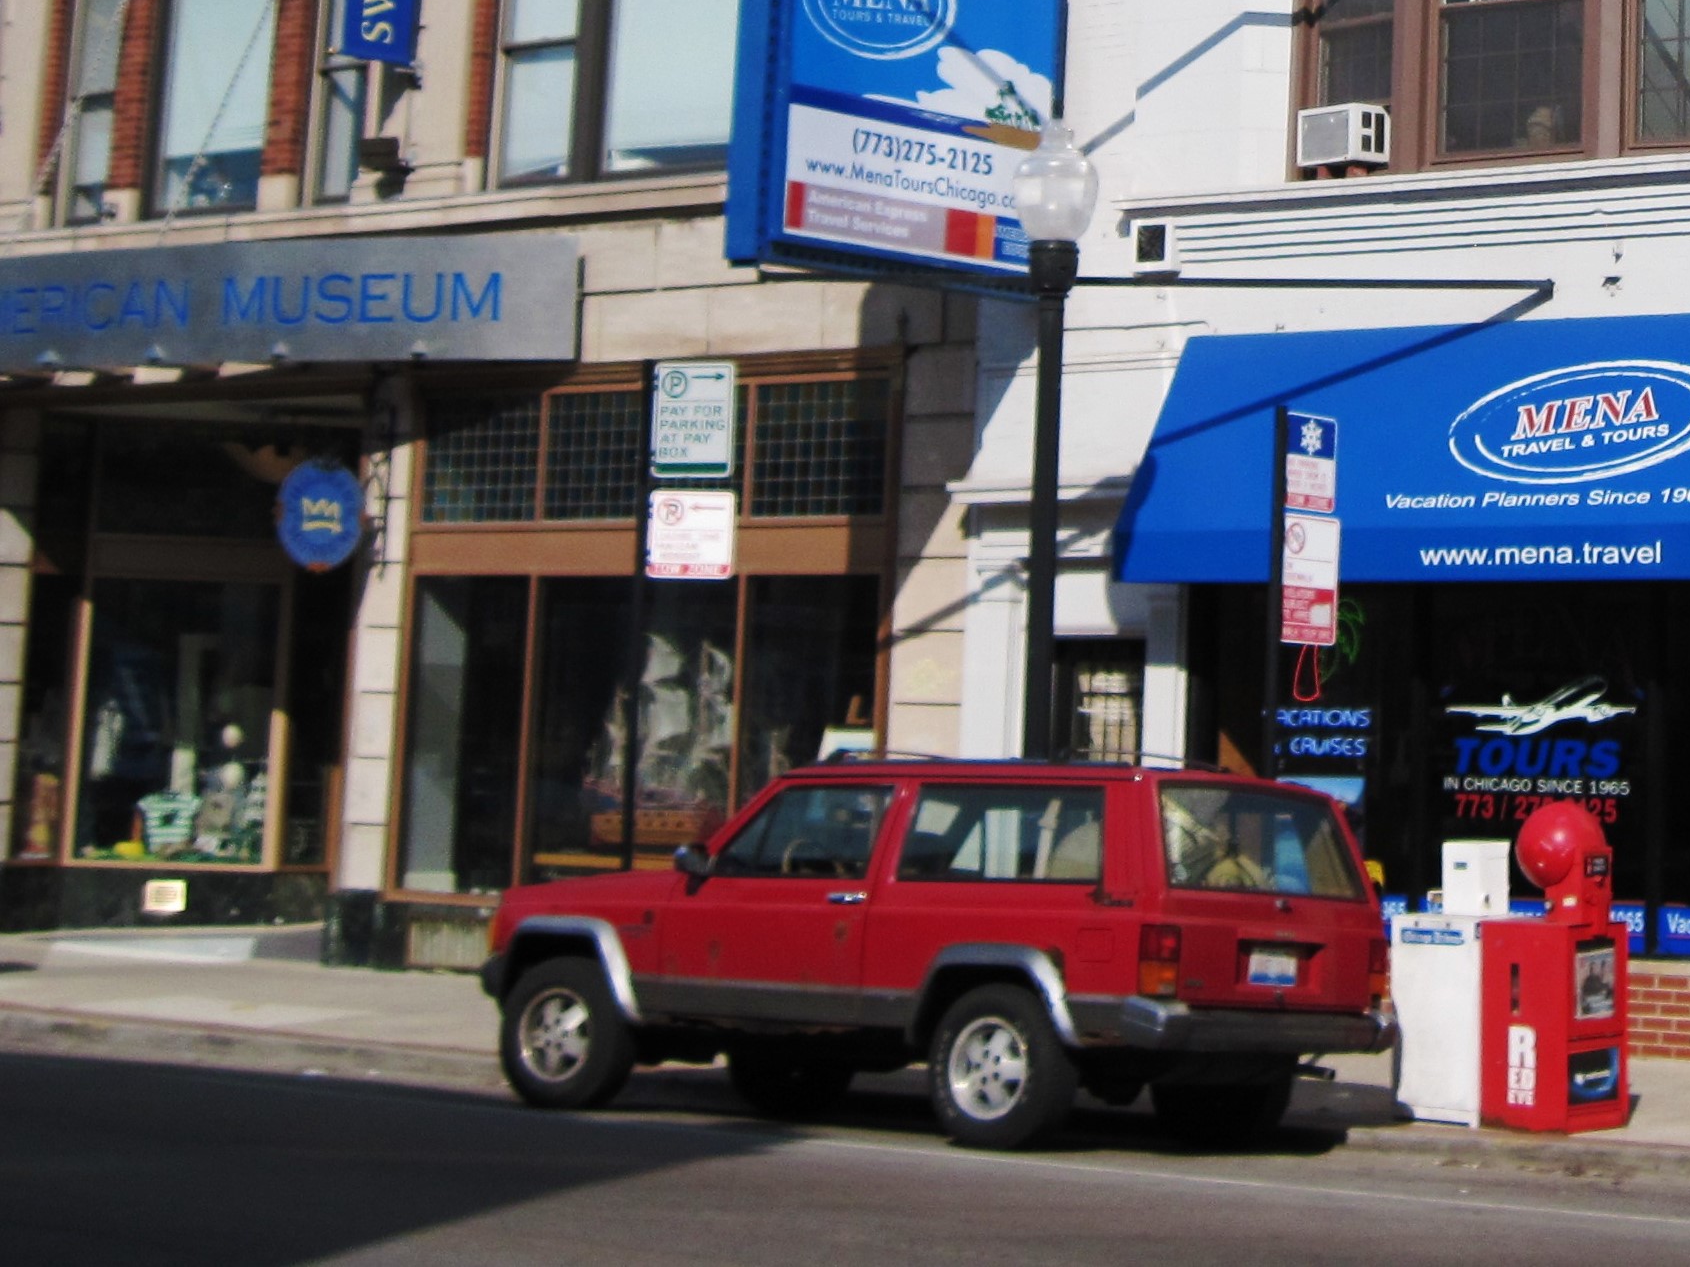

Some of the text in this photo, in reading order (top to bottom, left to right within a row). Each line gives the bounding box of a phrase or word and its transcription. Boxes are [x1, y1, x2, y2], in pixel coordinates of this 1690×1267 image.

[832, 8, 871, 23] TOURS
[888, 12, 931, 28] TRAVEL
[853, 127, 993, 176] (773)275-2125
[808, 189, 927, 223] American Express
[807, 210, 849, 229] Travel
[222, 272, 503, 325] MUSEUM
[660, 406, 722, 417] PAY FOR
[1510, 386, 1660, 442] MENA
[660, 420, 726, 431] PARKING
[661, 434, 711, 444] AT PAY
[1501, 423, 1669, 458] TRAVEL & TOURS
[659, 447, 688, 458] BOX
[1385, 492, 1475, 510] Vacation
[1481, 491, 1580, 508] Planners
[1586, 489, 1651, 507] Since
[1420, 540, 1662, 566] www.mena.travel
[1277, 709, 1371, 728] ACATIONS
[1289, 737, 1366, 755] CRUISES
[1455, 738, 1621, 778] TOURS
[1443, 777, 1631, 795] IN CHICAGO SINCE 1965
[1455, 793, 1494, 818] 773
